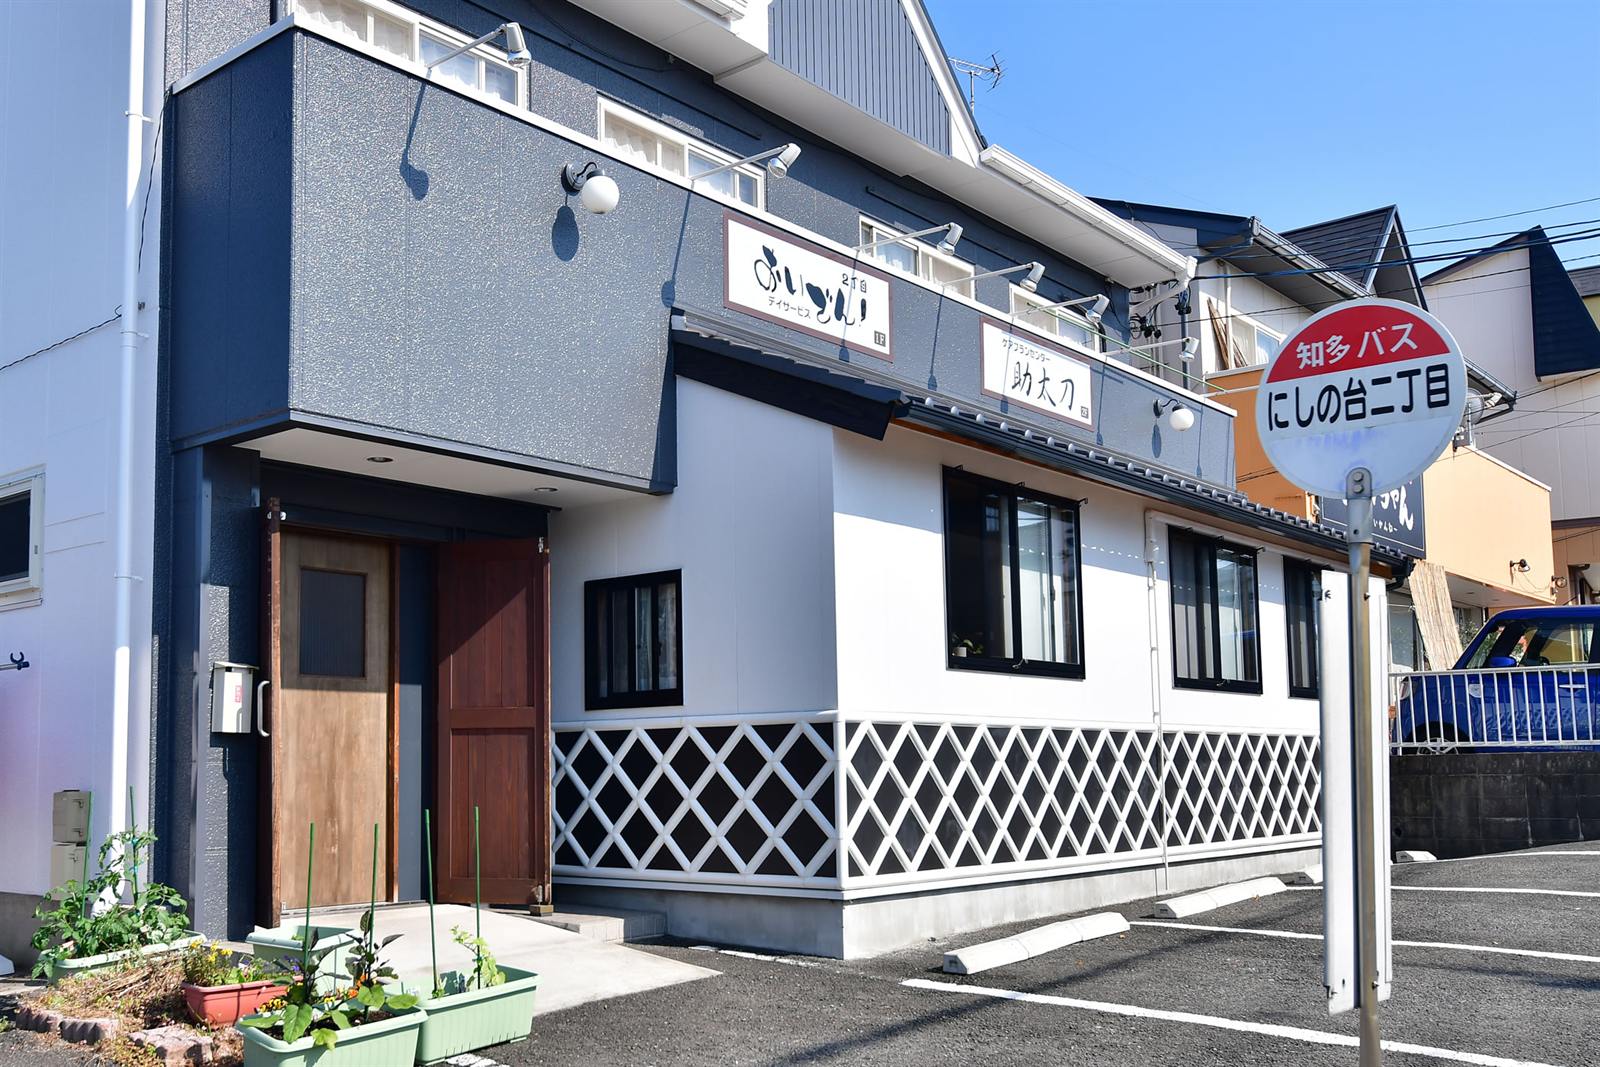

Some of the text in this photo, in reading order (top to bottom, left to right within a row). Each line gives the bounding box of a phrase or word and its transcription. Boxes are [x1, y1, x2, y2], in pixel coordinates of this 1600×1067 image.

[842, 272, 867, 293] 2丁目
[768, 296, 811, 320] デイサービス
[1002, 338, 1051, 362] ケアプランセンター
[1011, 361, 1075, 411] 助太刀
[1268, 363, 1450, 431] にしの台二丁目
